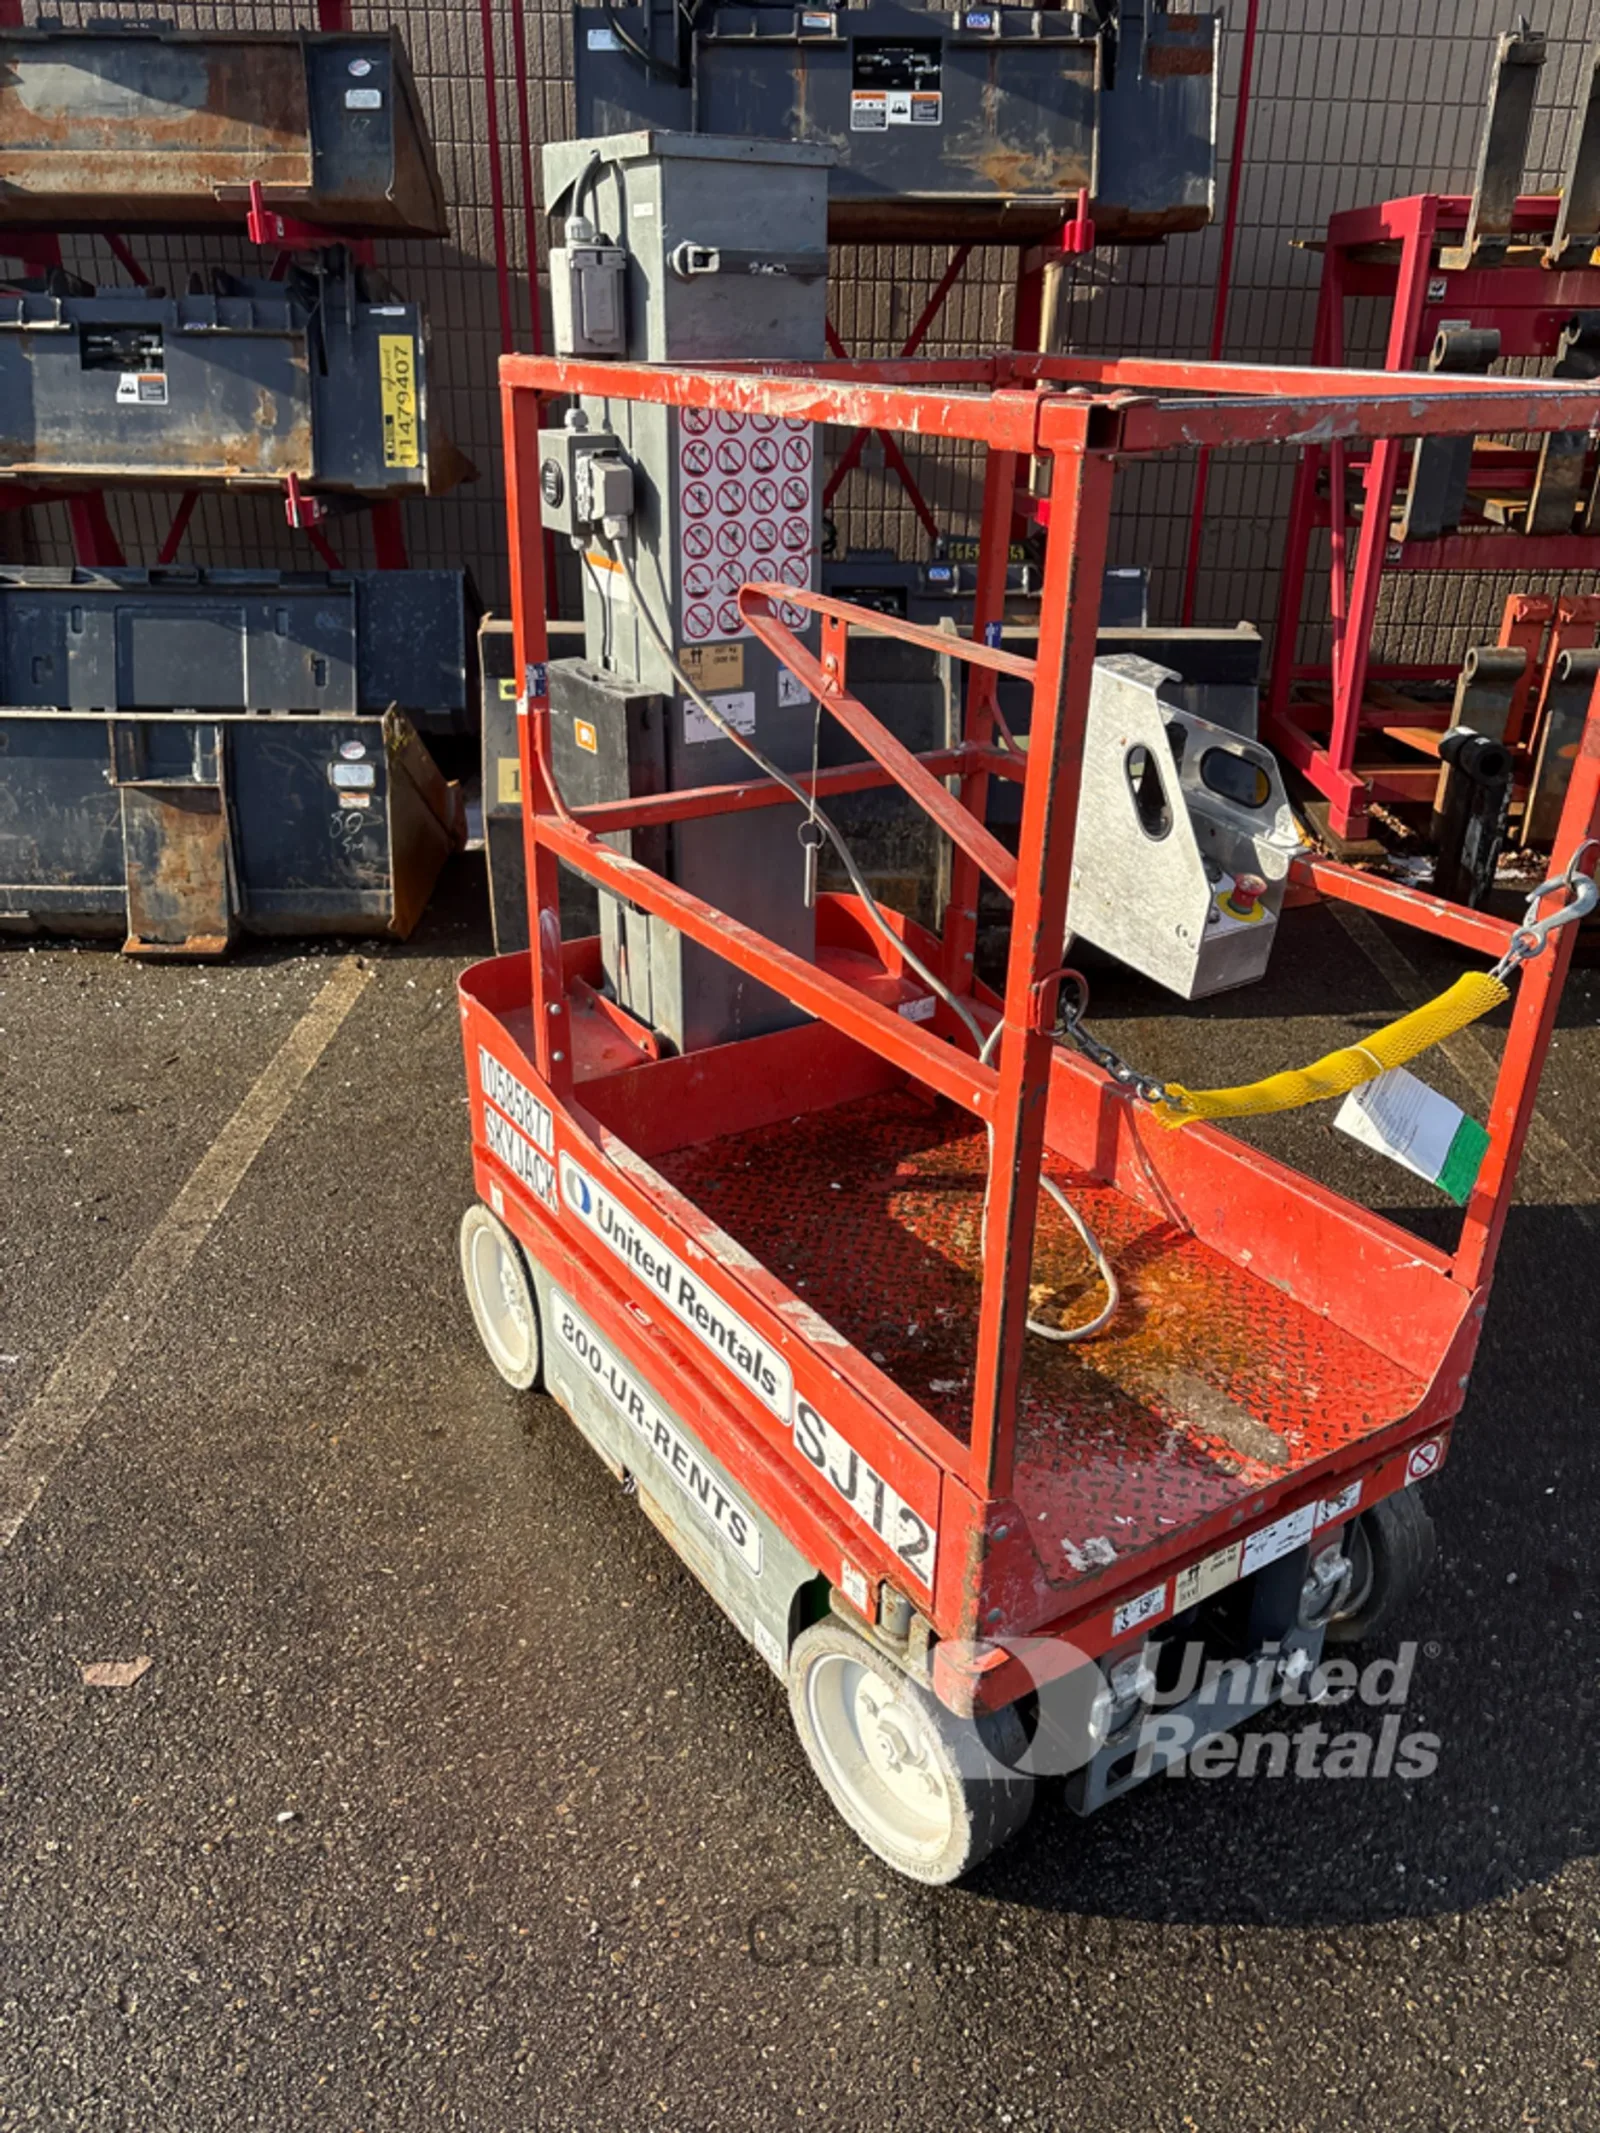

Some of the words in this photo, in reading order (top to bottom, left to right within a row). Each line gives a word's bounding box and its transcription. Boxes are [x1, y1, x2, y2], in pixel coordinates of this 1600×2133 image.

[394, 345, 413, 463] 11479407
[485, 1106, 558, 1211] SKYJACK
[597, 1197, 671, 1294] United
[678, 1276, 777, 1397] Rentals
[562, 1313, 748, 1548] 800-UR-RENTS
[796, 1401, 929, 1585] SJ12
